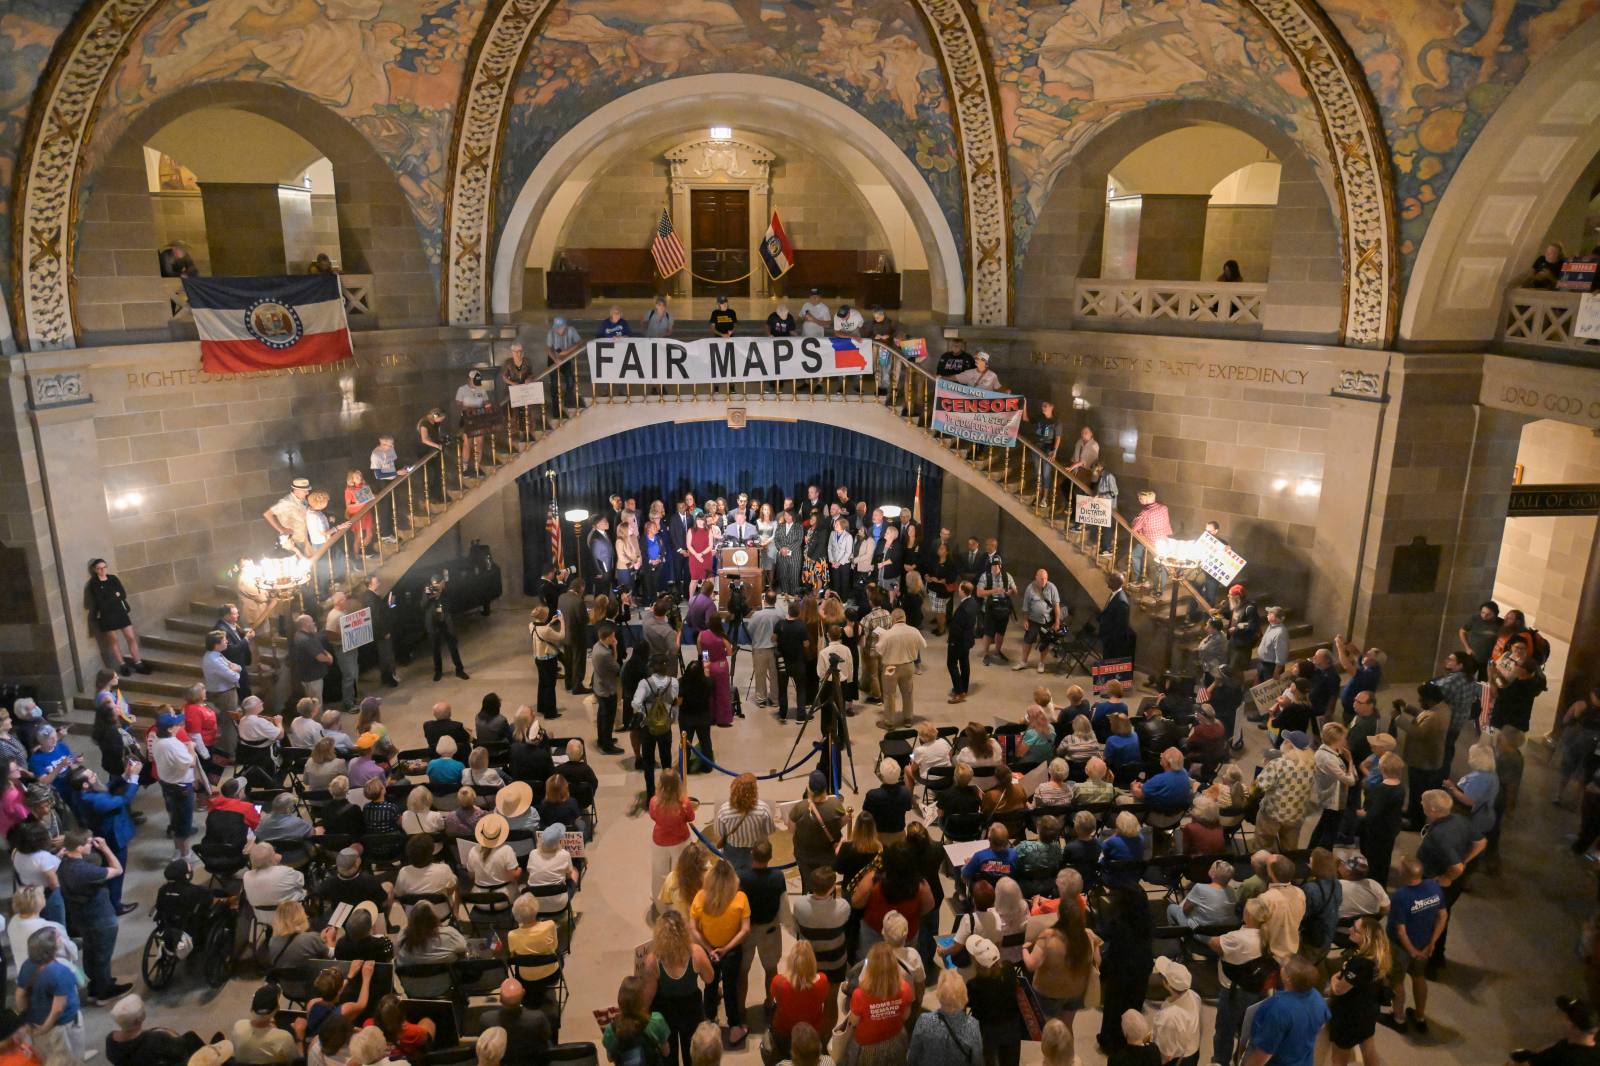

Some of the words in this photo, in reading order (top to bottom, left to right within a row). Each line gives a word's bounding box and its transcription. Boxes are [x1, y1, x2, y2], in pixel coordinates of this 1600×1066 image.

[595, 341, 690, 379] FAIR
[709, 337, 823, 379] MAPS
[1159, 360, 1205, 377] PARTY
[1208, 364, 1310, 385] EXPEDIENCY
[948, 383, 968, 394] WILL
[969, 389, 986, 398] NOT
[941, 399, 1019, 413] CENSOR
[1501, 386, 1539, 407] LORD
[1544, 394, 1583, 415] GOD
[943, 423, 1010, 445] IGNORANCE
[1080, 507, 1107, 517] DICTATOR
[1090, 502, 1100, 510] NO
[1079, 514, 1108, 525] MISSOURI
[870, 1002, 891, 1010] MOMS
[870, 1005, 899, 1014] DEMAND
